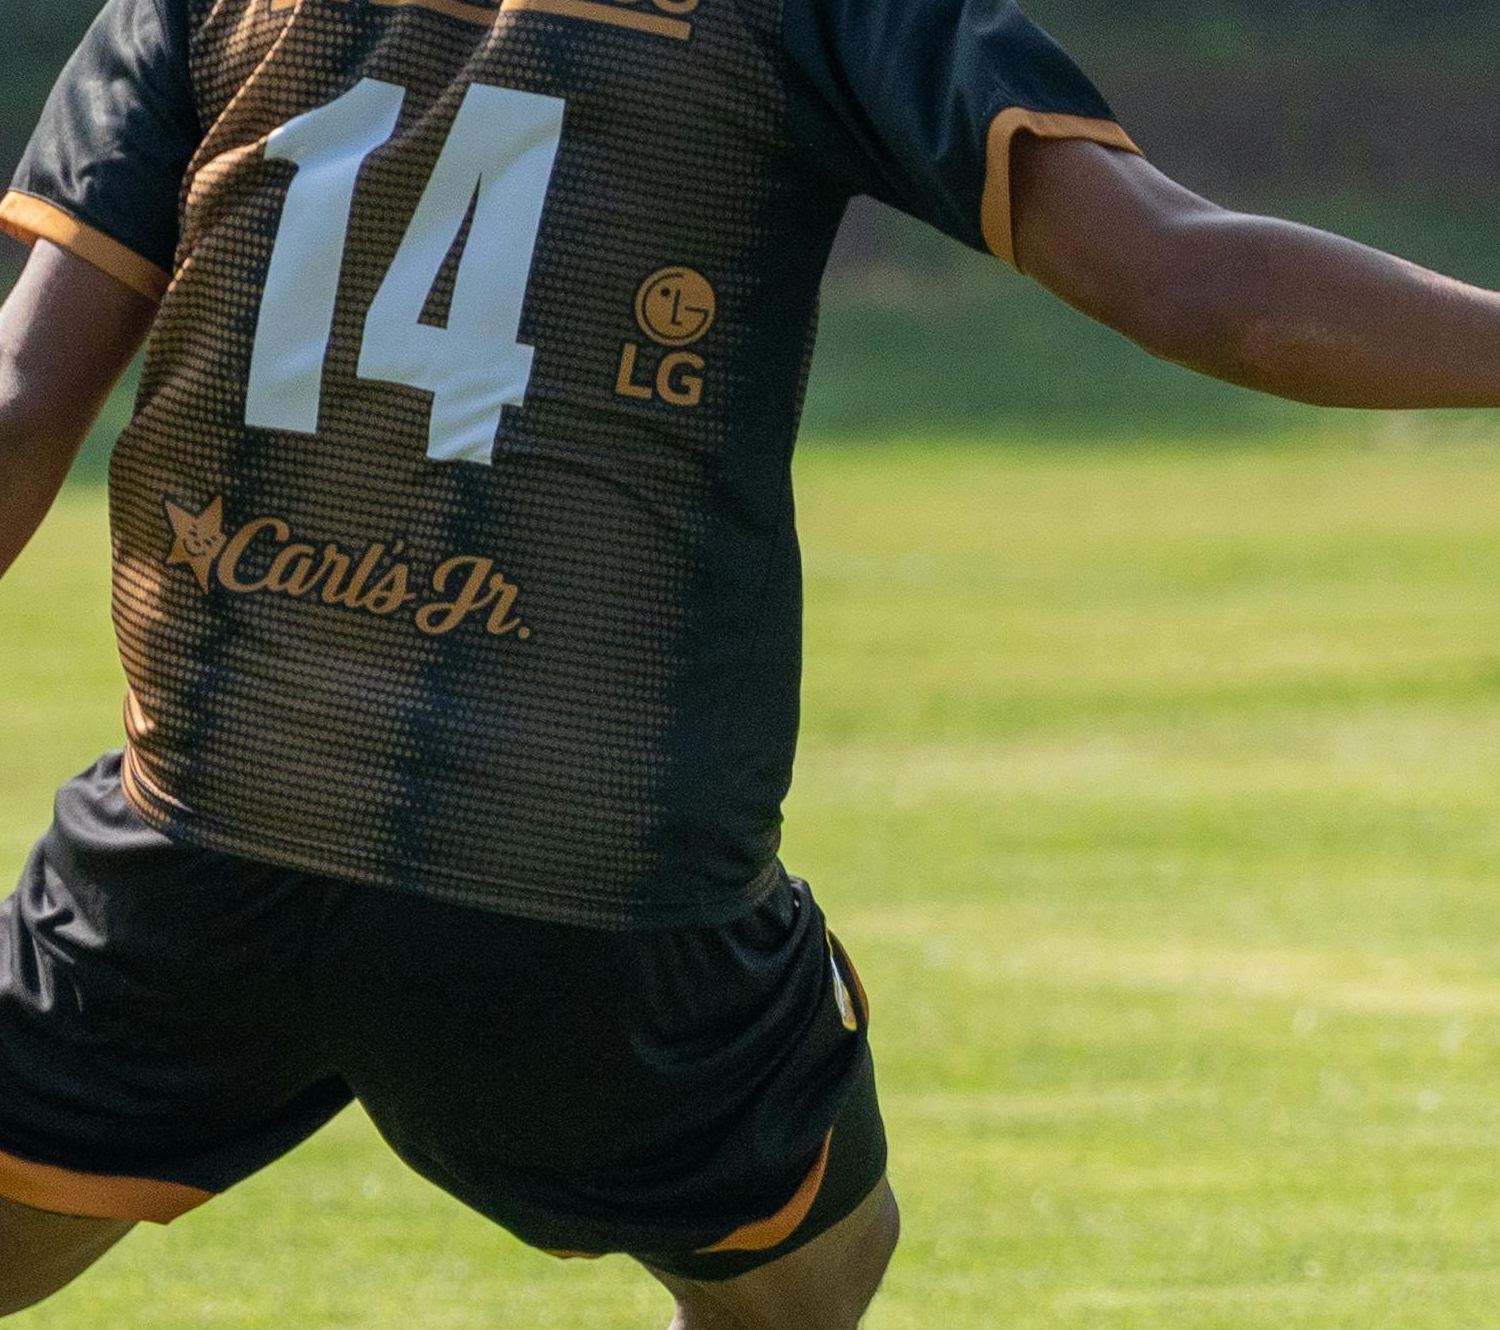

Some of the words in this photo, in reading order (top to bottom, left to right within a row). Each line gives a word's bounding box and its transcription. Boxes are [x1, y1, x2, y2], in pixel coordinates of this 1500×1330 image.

[244, 76, 565, 465] 14
[615, 343, 705, 406] LG
[217, 518, 416, 614] Carl's
[414, 555, 530, 639] Jr.
